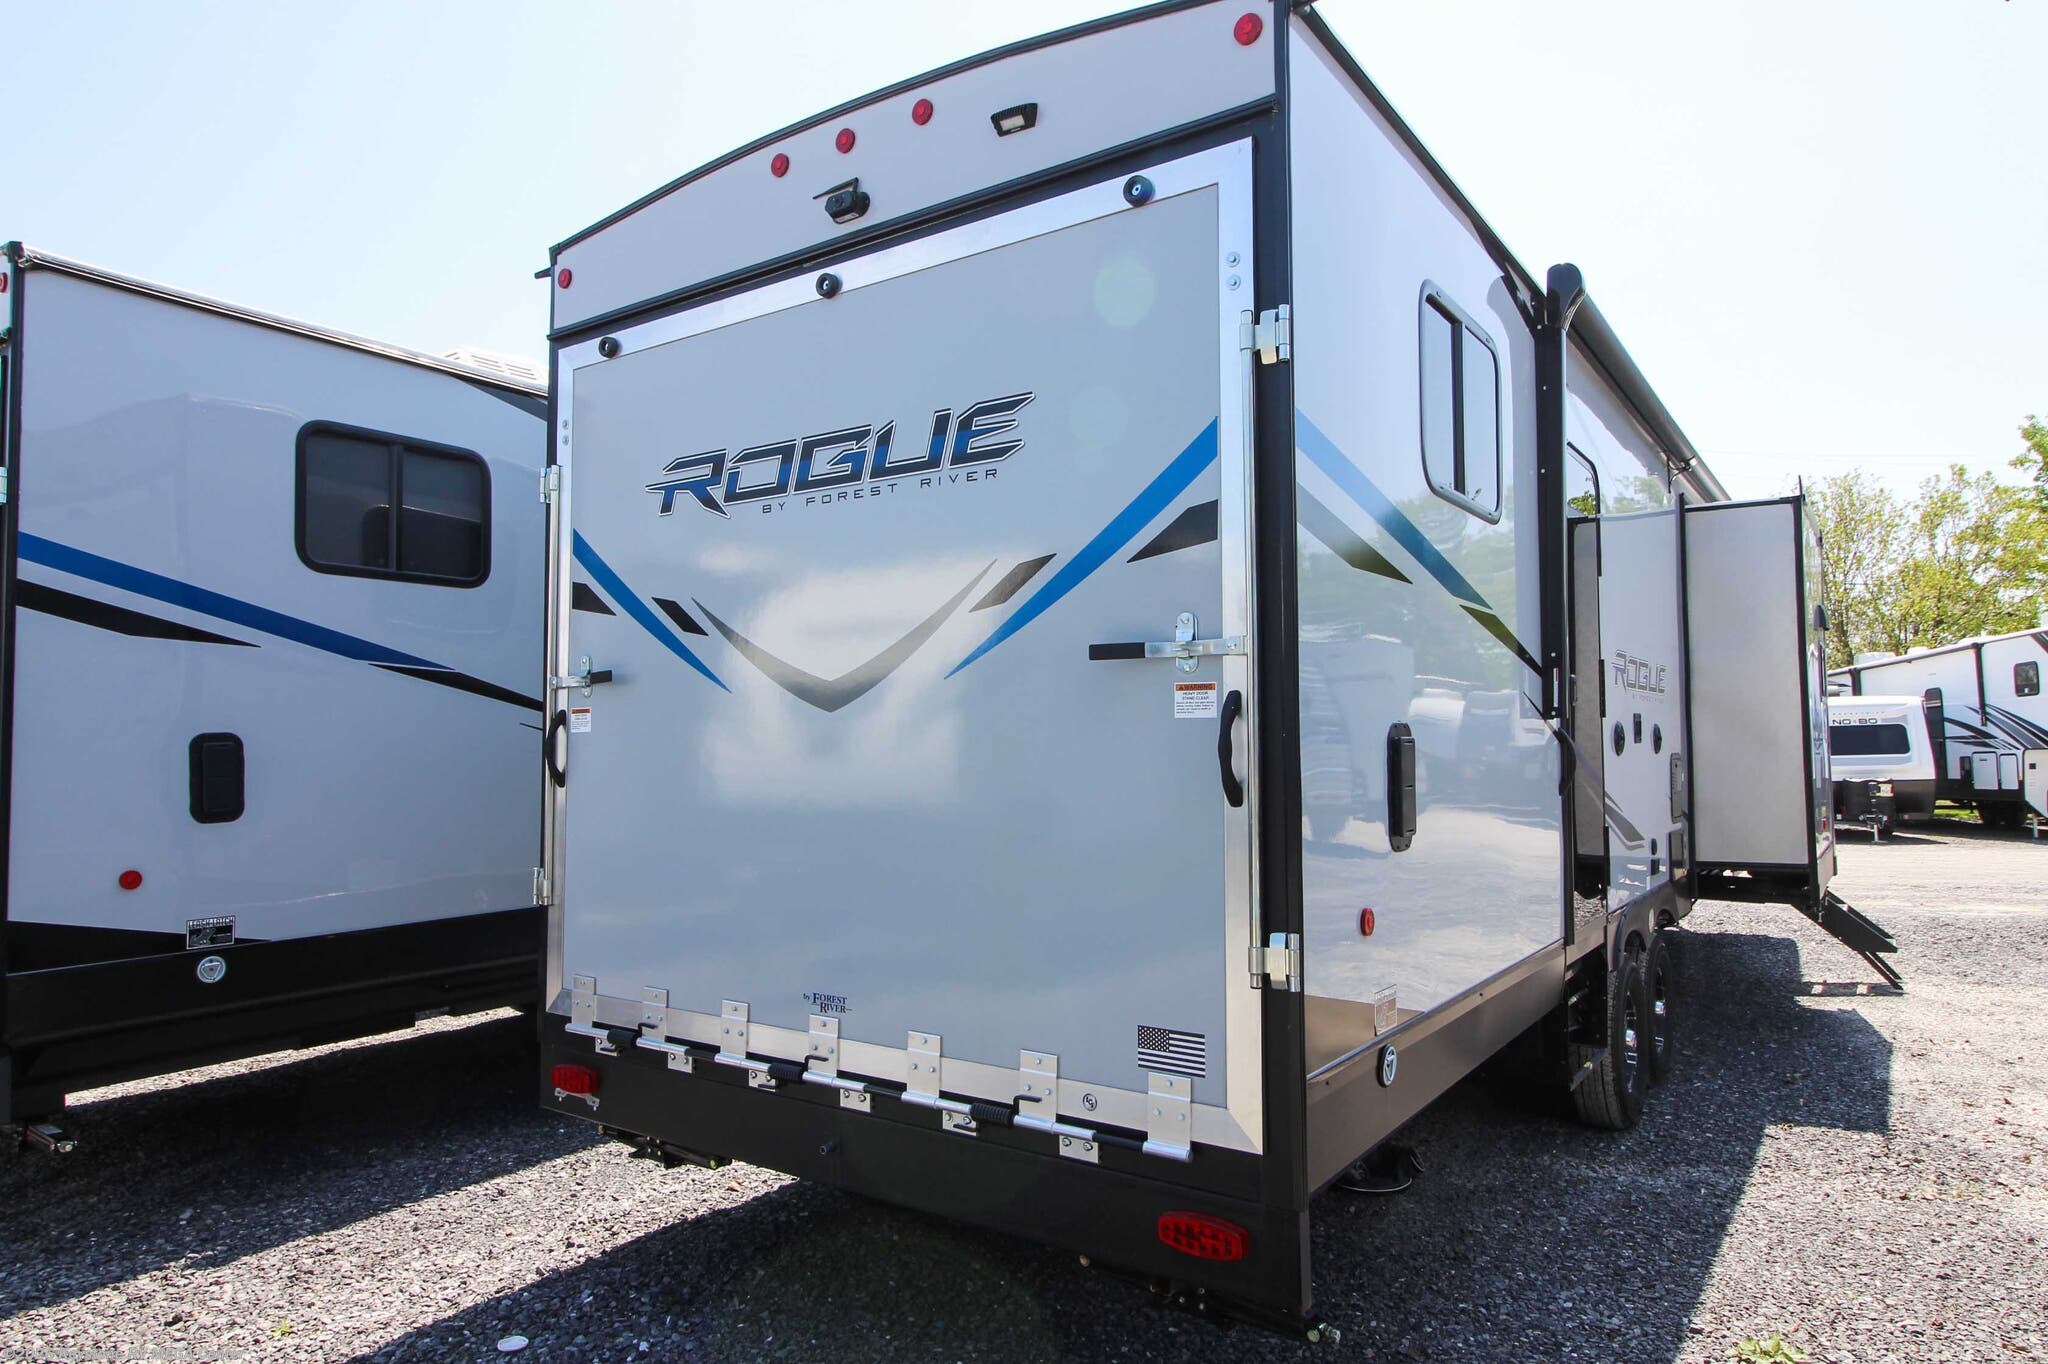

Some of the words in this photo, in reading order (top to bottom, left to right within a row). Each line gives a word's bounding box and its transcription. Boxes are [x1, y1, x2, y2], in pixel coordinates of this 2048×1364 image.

[645, 391, 1036, 519] ROGUE
[761, 501, 787, 515] BY
[805, 483, 899, 508] FOREST
[919, 467, 1000, 489] RIVER
[1611, 648, 1668, 695] ROGUE
[812, 992, 848, 1005] FOREST
[819, 1002, 846, 1014] RIVER
